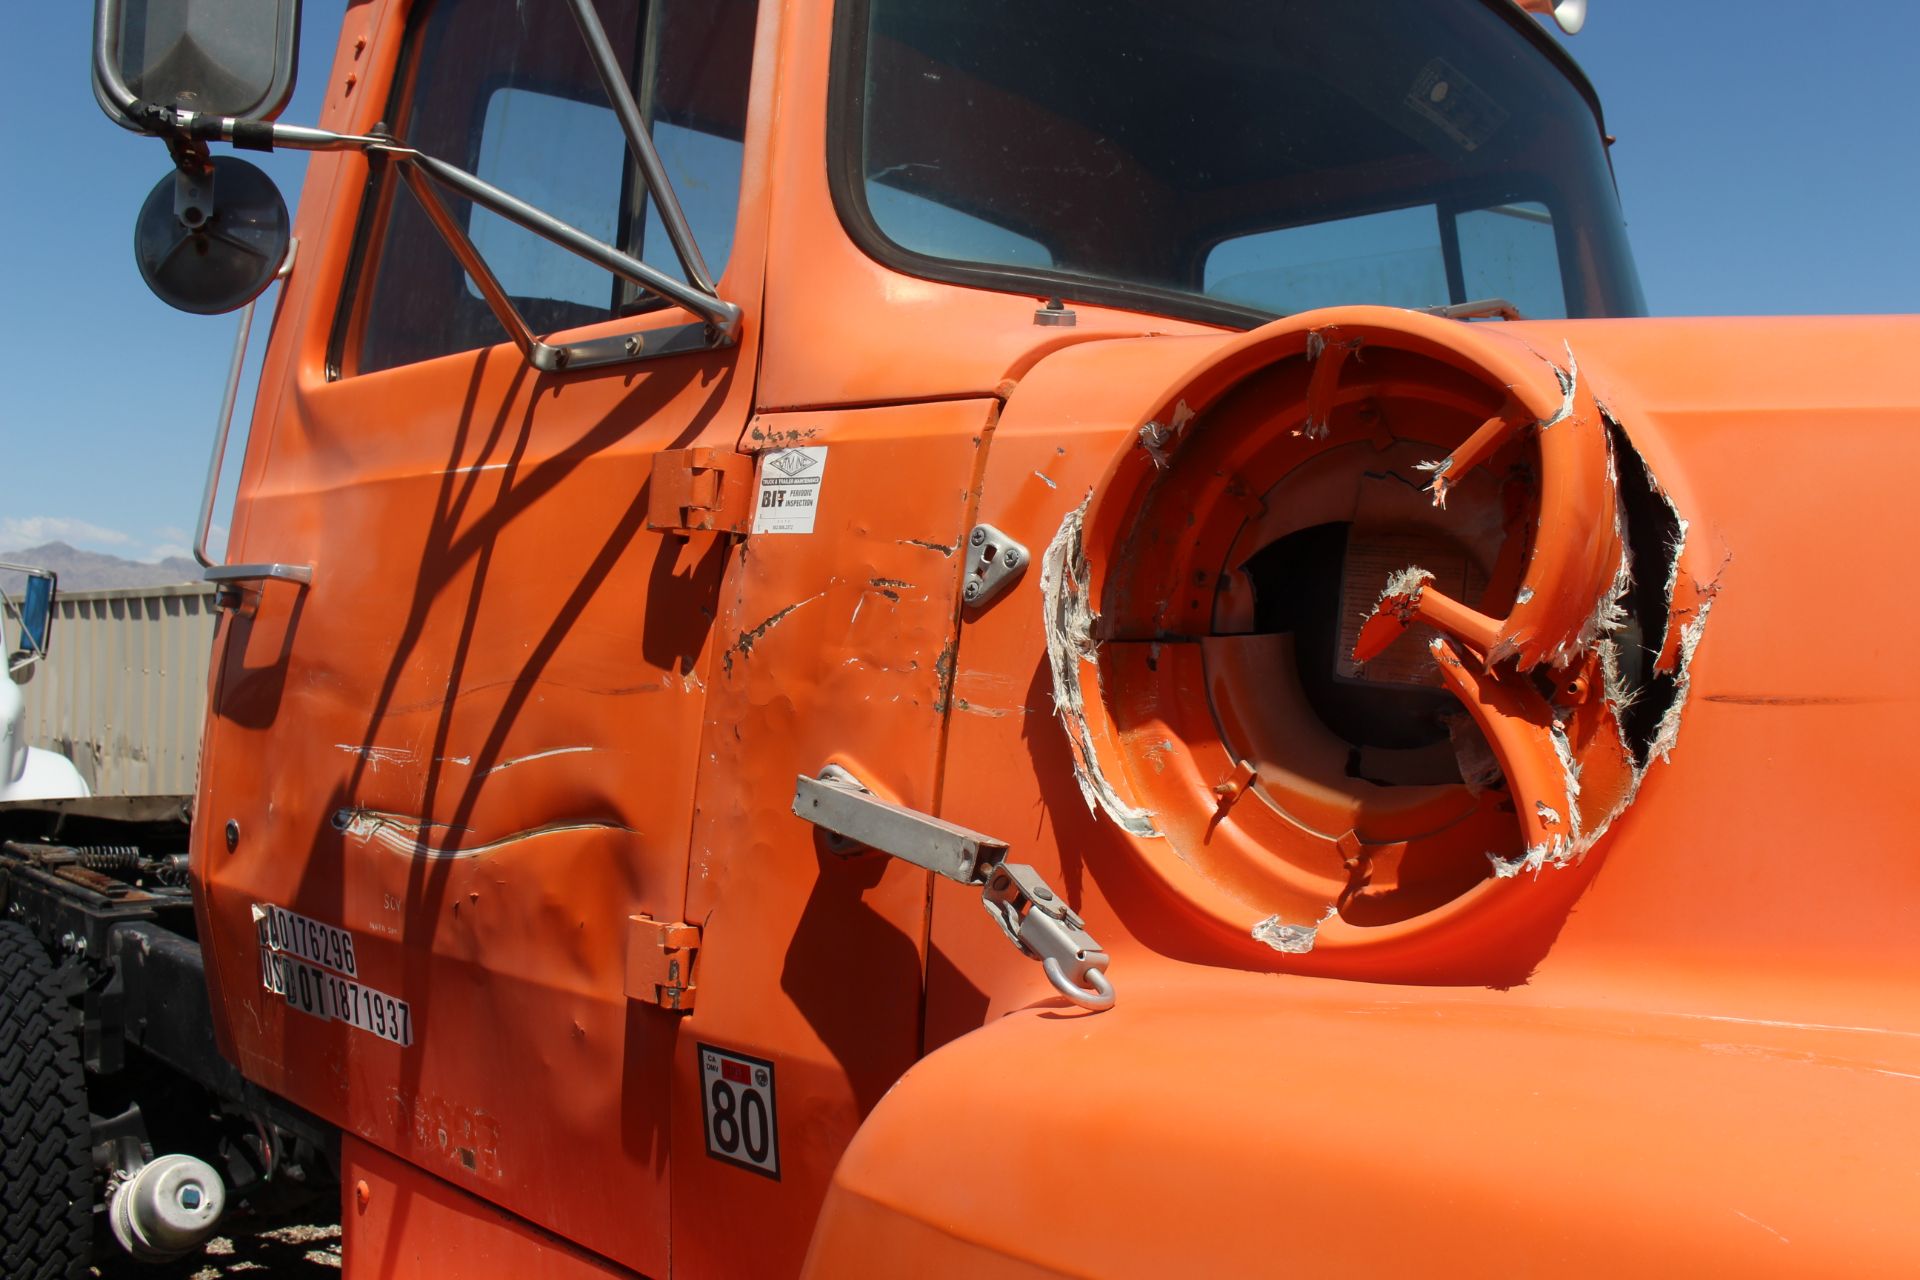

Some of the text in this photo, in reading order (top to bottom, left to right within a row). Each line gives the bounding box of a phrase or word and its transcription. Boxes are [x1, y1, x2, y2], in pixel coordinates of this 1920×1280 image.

[790, 489, 812, 497] PERIODIC
[761, 490, 786, 508] BIT
[785, 499, 813, 507] INSPECTION
[707, 1055, 717, 1063] CA
[706, 1063, 719, 1073] DMV
[712, 1079, 769, 1163] 80
